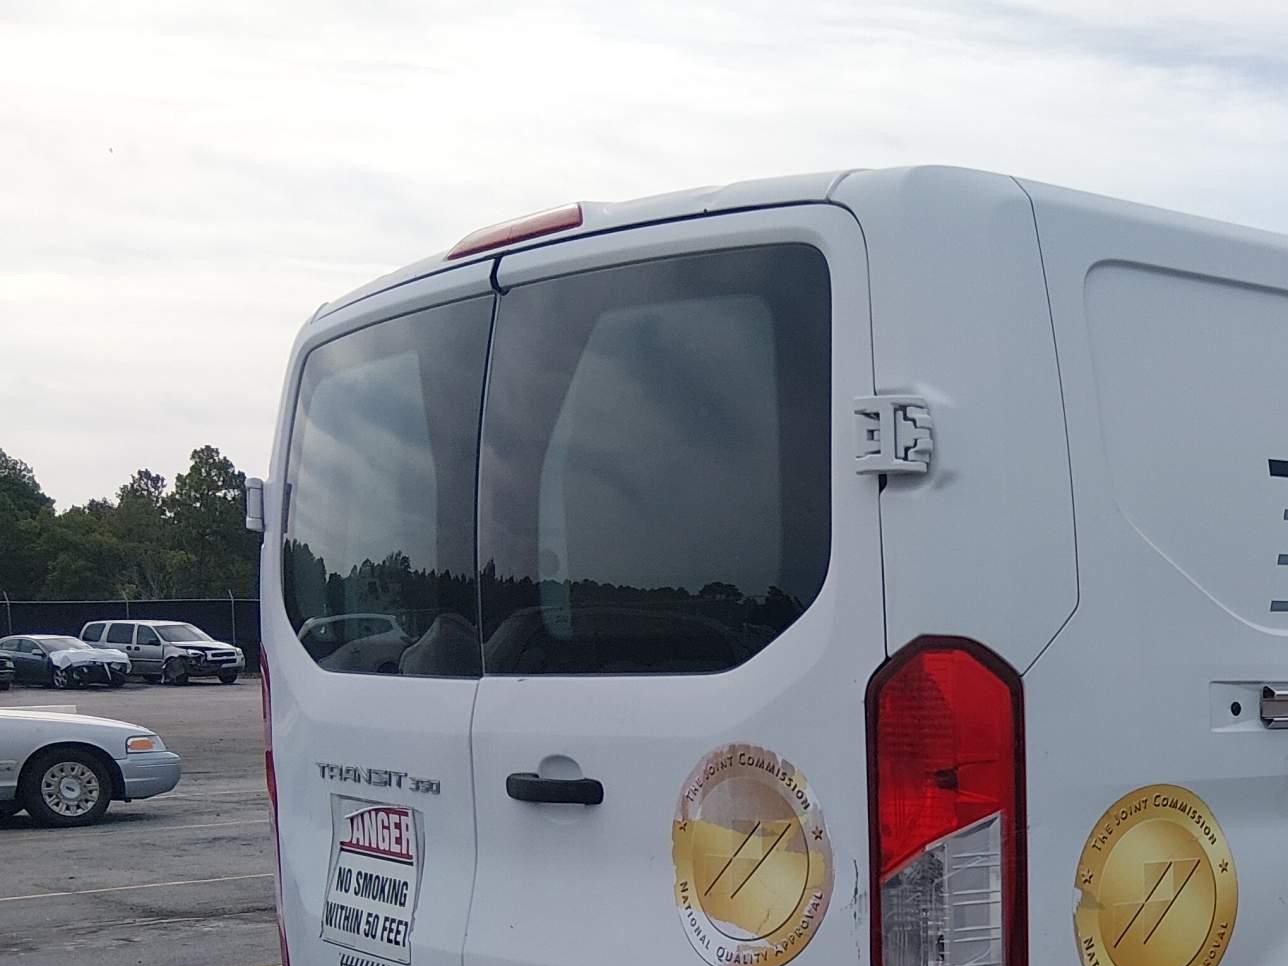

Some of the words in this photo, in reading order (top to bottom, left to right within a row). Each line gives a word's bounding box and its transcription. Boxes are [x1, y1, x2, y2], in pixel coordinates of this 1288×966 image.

[316, 762, 408, 789] TRANSIT
[686, 778, 704, 802] THE
[738, 752, 811, 811] COMMISSION
[1091, 824, 1113, 852] THE
[1115, 798, 1149, 826] JOINT
[1153, 794, 1217, 846] COMMISSION
[335, 866, 353, 893] NO
[353, 870, 409, 908] SMOKING
[325, 901, 364, 936] WITHIN
[363, 912, 380, 940] 50
[679, 880, 711, 950] NATIONAL
[716, 946, 769, 965] QUALITY
